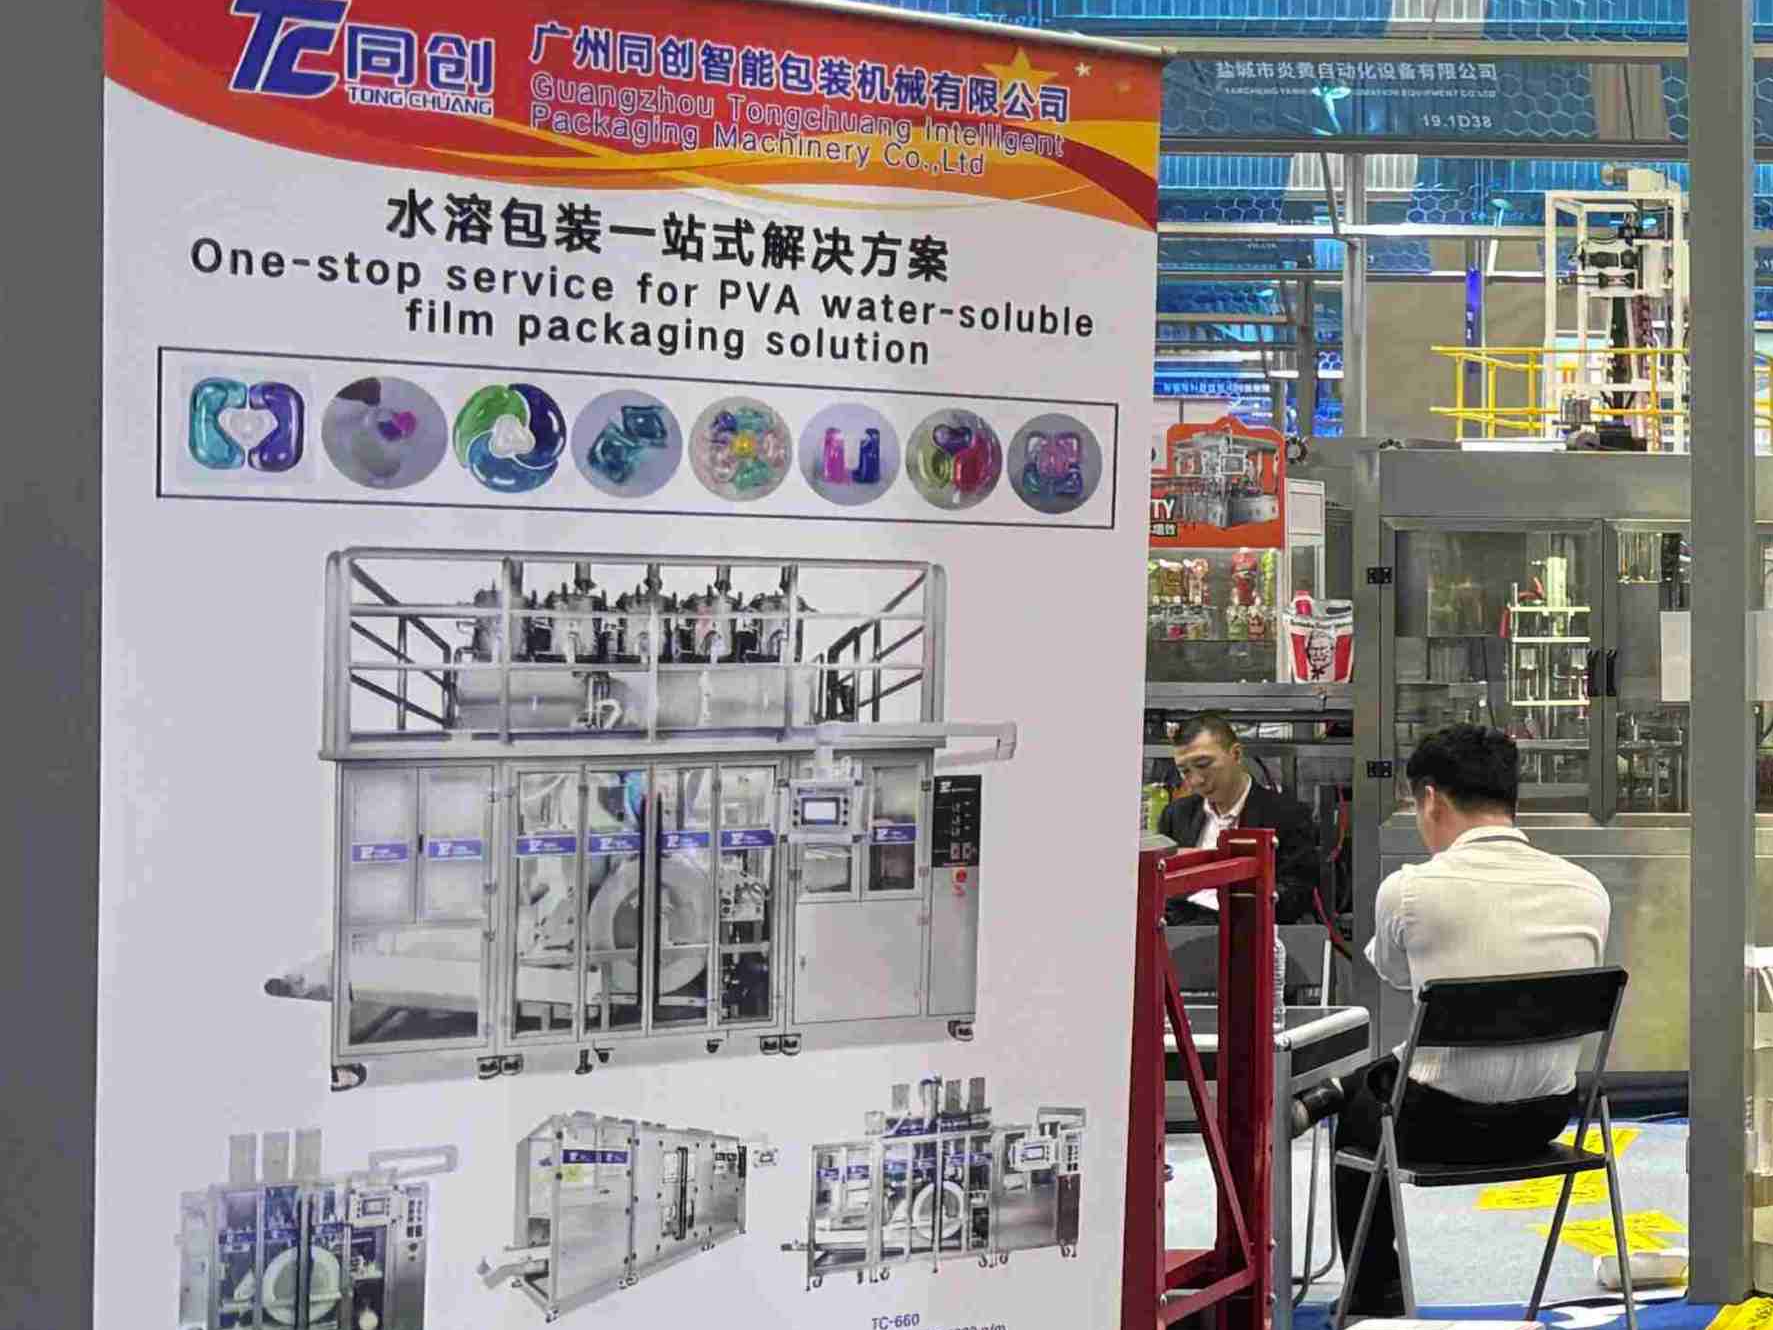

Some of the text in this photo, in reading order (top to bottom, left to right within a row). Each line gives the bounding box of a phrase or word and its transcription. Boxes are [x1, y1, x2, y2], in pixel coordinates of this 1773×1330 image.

[343, 21, 497, 99] 同创
[530, 21, 1070, 125] 广州同创智能包装机械有限公司
[349, 86, 493, 119] TONG CHUANG
[530, 72, 1066, 159] Guangzhou Tongchuang Intelligent
[530, 102, 701, 152] Packaging
[712, 120, 870, 168] Machinery
[1421, 113, 1493, 129] 19.1D38
[385, 186, 949, 283] 水溶包装一站式解决方案
[190, 236, 1094, 339] One-stop service for PVA water-soluble
[404, 298, 930, 366] film packaging solution
